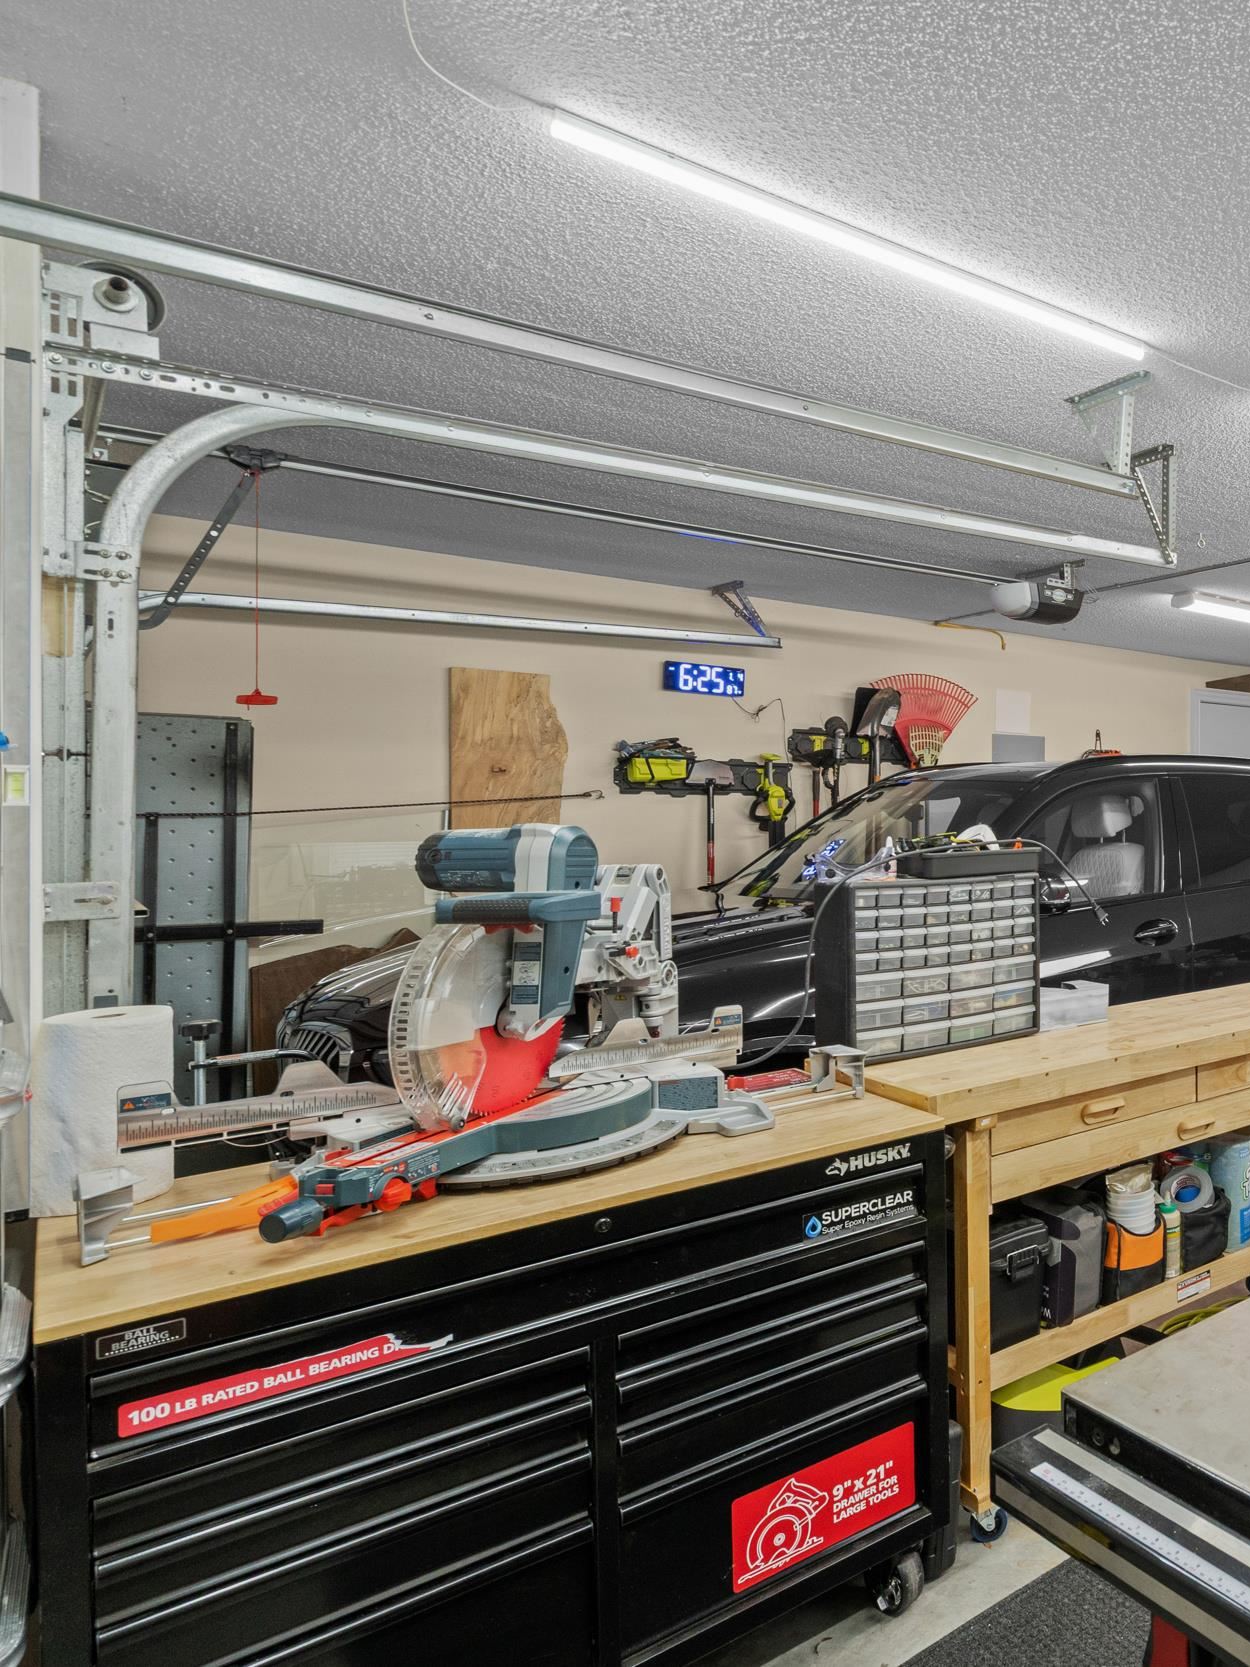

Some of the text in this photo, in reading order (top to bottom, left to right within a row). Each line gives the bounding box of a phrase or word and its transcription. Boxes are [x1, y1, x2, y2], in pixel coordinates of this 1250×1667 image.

[679, 664, 725, 694] 6:25
[849, 1143, 911, 1171] HUSKY
[821, 1190, 913, 1225] SUPERCLEAR
[821, 1204, 914, 1235] Super Epoxy Resin Systems
[111, 1330, 171, 1351] BEARING
[124, 1326, 157, 1341] BALL
[127, 1402, 171, 1426] 100
[175, 1398, 198, 1414] LB
[201, 1381, 259, 1406] RATED
[263, 1368, 305, 1389] BALL
[308, 1346, 380, 1376] BEARING
[832, 1460, 894, 1502] 9" x 21"
[833, 1475, 898, 1513] DRAWER FOR
[833, 1484, 900, 1524] LARGE TOOLS
